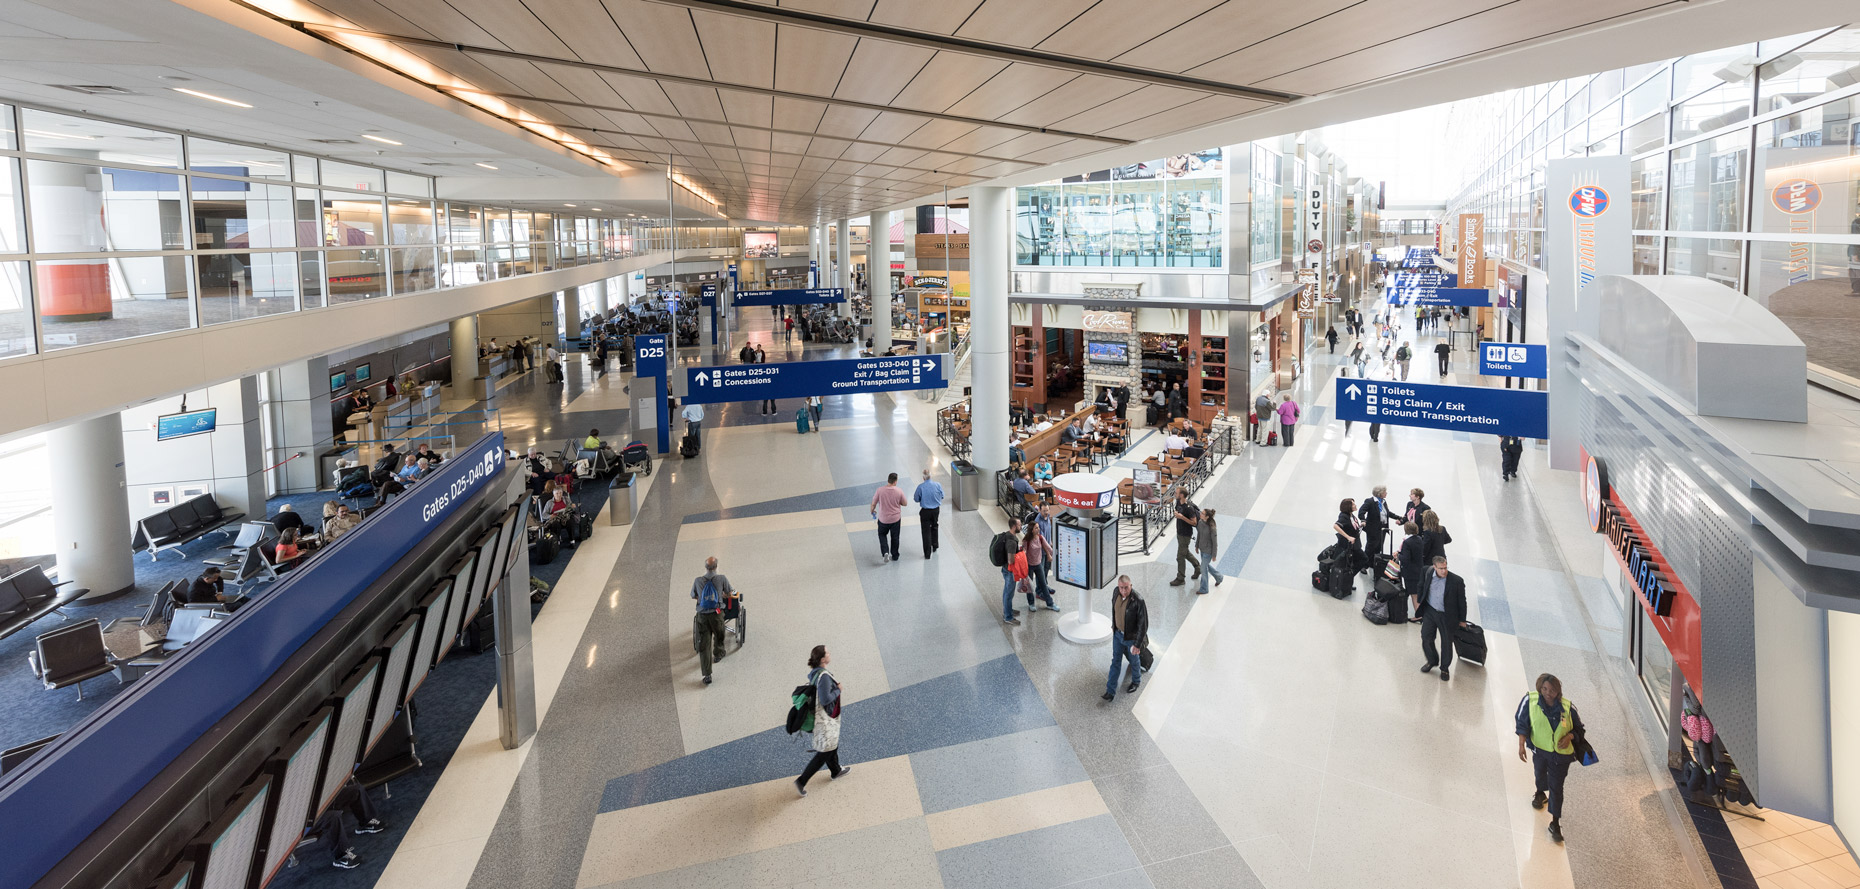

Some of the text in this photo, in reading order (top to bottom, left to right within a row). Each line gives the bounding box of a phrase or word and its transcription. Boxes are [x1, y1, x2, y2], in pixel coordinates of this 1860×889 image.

[1581, 188, 1595, 216] DFW
[1312, 190, 1320, 230] DUTY
[1466, 218, 1477, 284] Simply Books
[640, 348, 664, 358] D25
[857, 359, 909, 369] Gates D33-D40
[1486, 362, 1512, 370] Toilets
[724, 367, 780, 378] Gates D25-D31
[854, 370, 868, 378] Exit
[875, 369, 890, 378] Bag
[892, 368, 910, 376] Claim
[724, 376, 772, 386] Concessions
[832, 377, 910, 389] Ground Transportation
[1382, 386, 1415, 396] Toilets
[1382, 397, 1401, 408] Bag
[1404, 398, 1433, 409] Claim
[1446, 402, 1465, 411] Exit
[1382, 408, 1500, 426] Ground Transportation
[423, 462, 484, 522] Gates D25-D40
